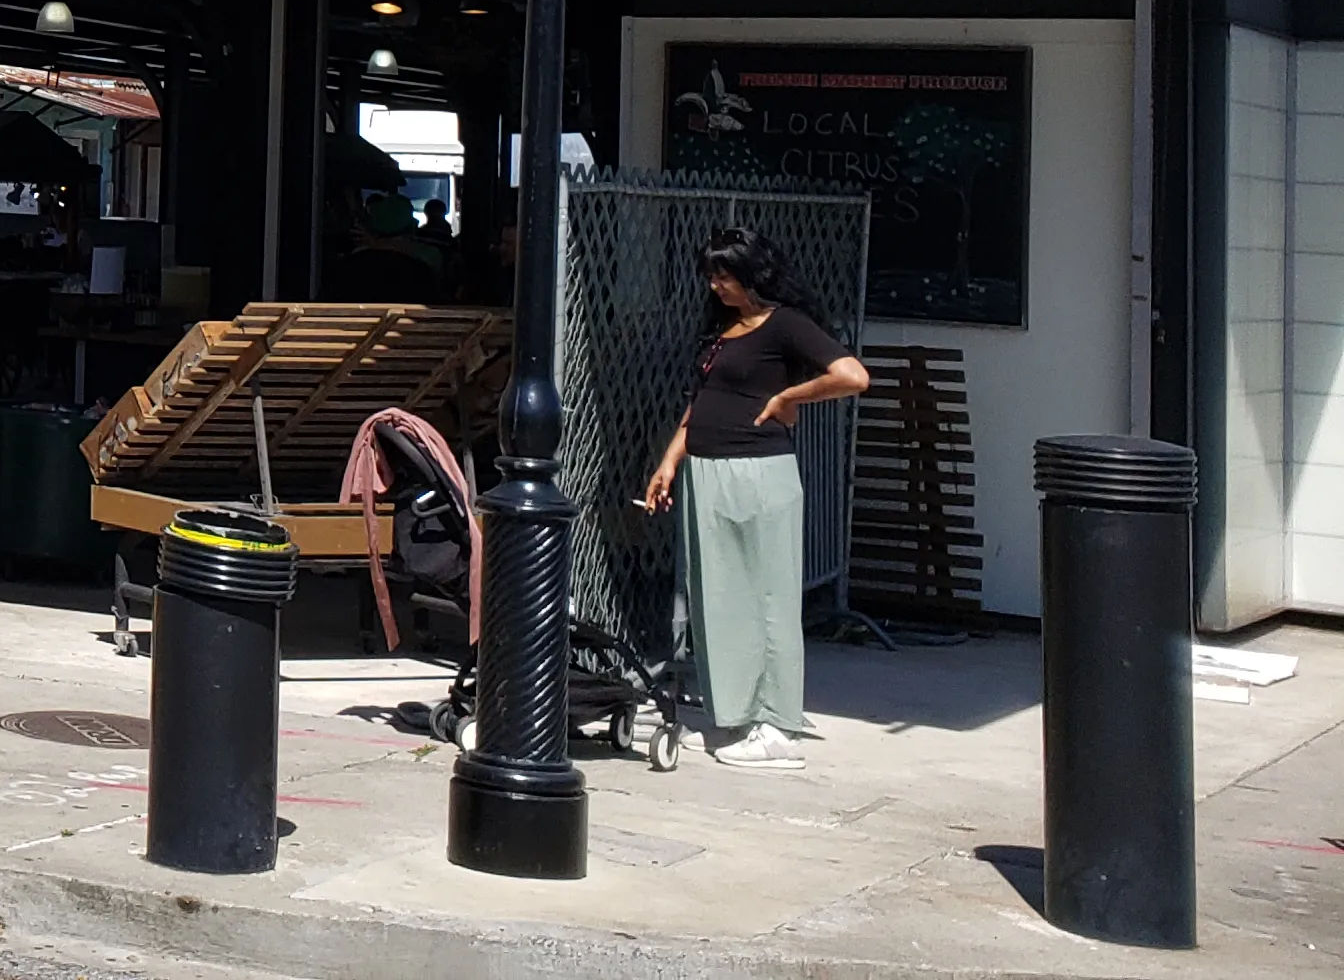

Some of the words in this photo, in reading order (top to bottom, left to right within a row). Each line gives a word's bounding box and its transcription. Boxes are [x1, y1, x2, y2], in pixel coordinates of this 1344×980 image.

[909, 75, 1007, 91] PRODUCE
[762, 110, 885, 136] LOCAL
[780, 147, 901, 182] CITRUS
